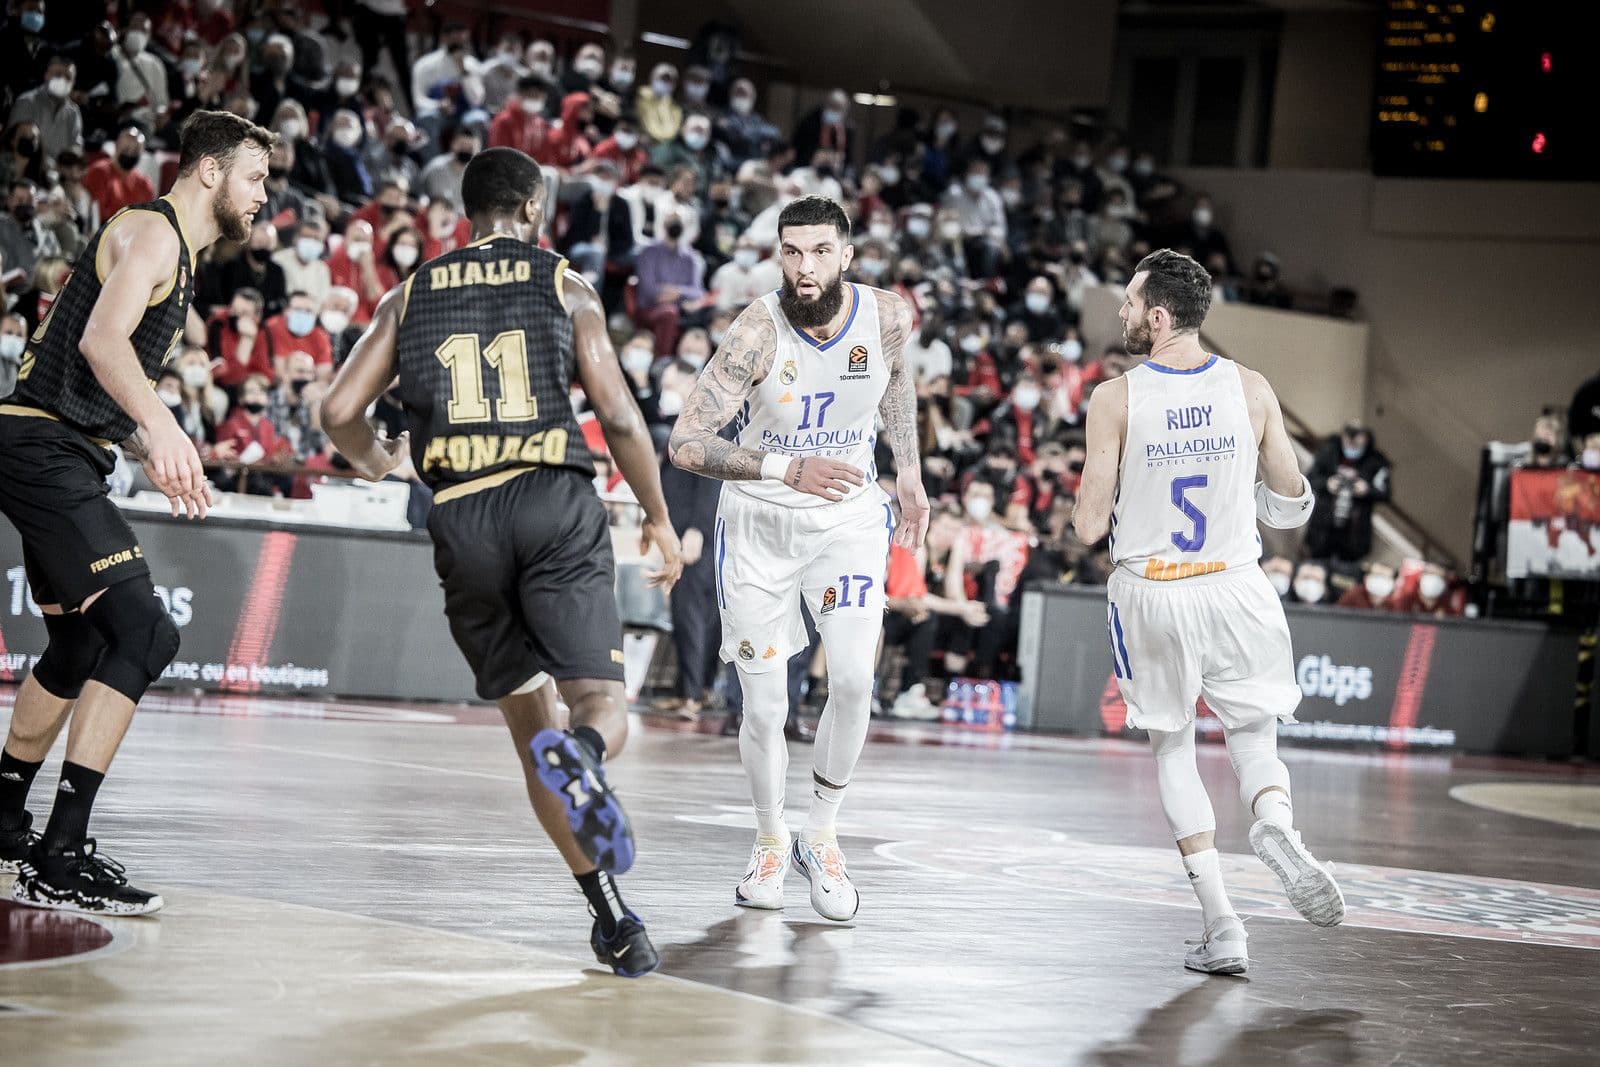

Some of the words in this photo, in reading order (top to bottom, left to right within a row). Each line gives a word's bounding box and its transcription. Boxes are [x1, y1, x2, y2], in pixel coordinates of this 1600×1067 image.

[430, 259, 531, 290] DIALLO
[434, 329, 538, 424] 11
[797, 391, 835, 431] 17
[1166, 405, 1212, 430] RUDY
[762, 429, 863, 447] PALLADIUM
[1146, 435, 1235, 457] PALLADIUM
[1147, 459, 1185, 468] HOTEL
[1196, 453, 1235, 462] GROUP
[1171, 474, 1208, 552] 5
[90, 549, 133, 574] FEDCOM
[837, 574, 873, 608] 17
[1297, 654, 1373, 706] Gbps
